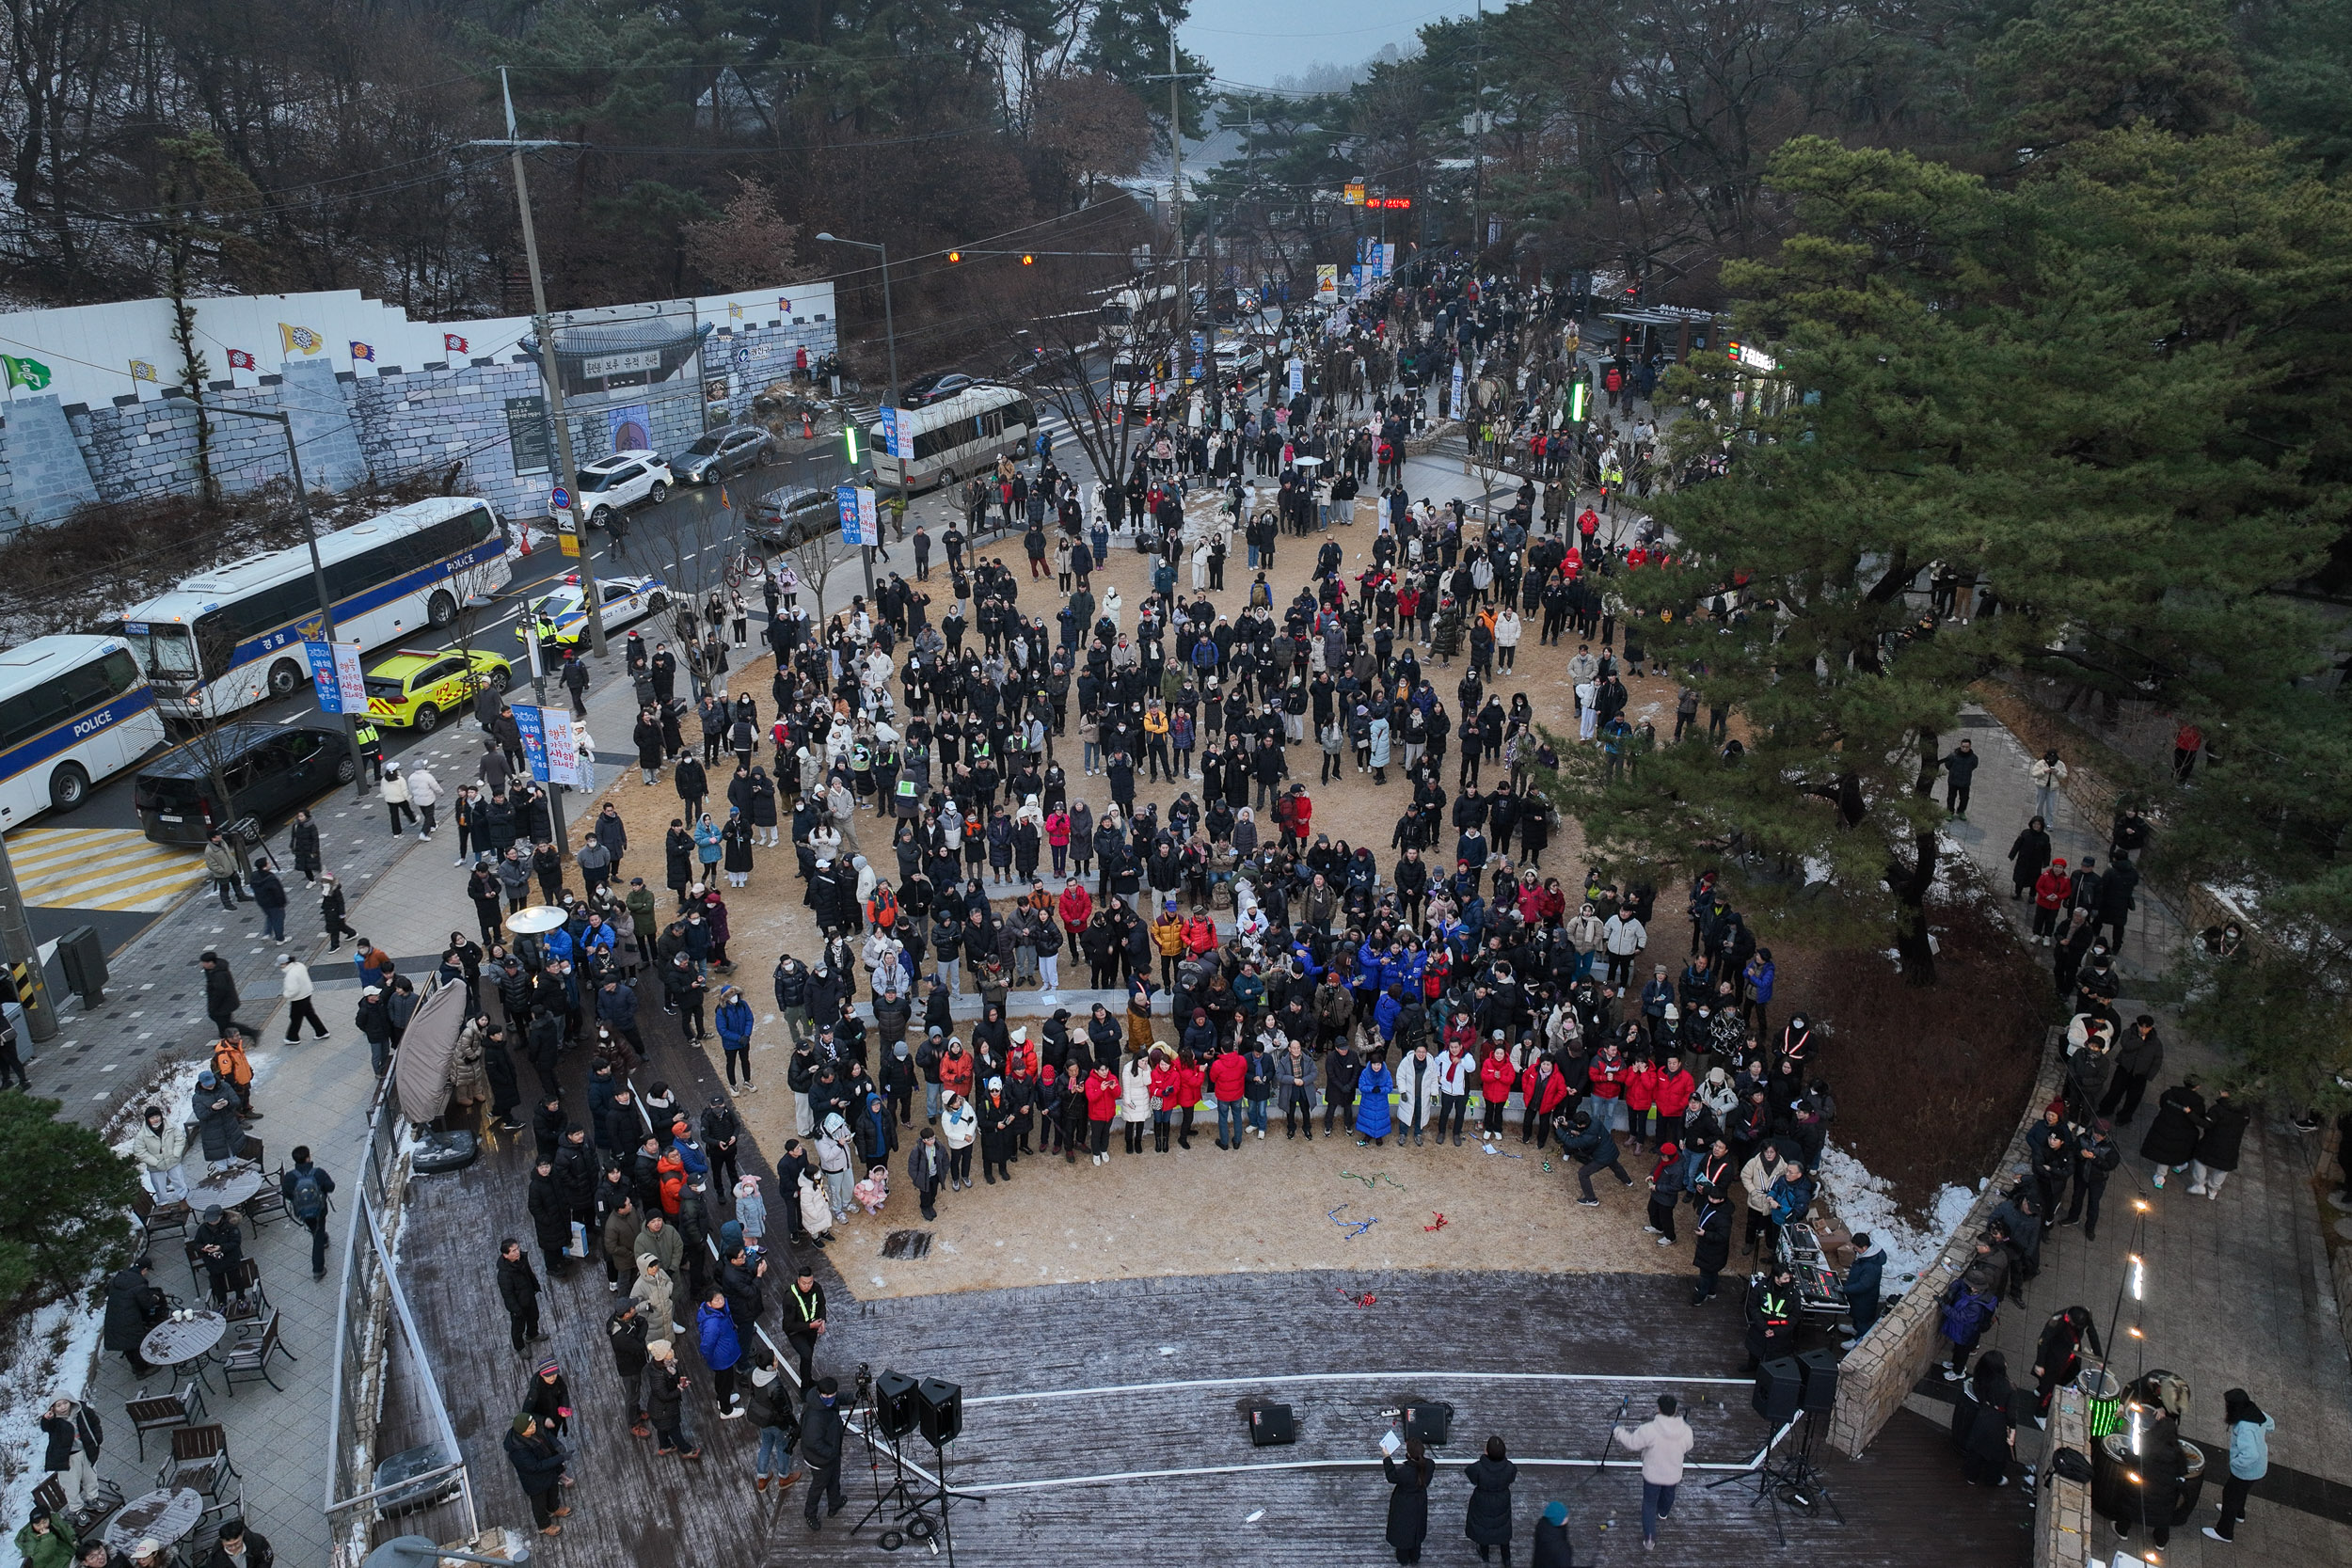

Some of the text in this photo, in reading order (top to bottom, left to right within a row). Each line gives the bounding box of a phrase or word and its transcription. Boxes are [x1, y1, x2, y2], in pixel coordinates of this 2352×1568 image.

[605, 358, 620, 371] 보루
[624, 356, 640, 369] 유적
[446, 553, 475, 572] POLICE
[600, 611, 612, 621] OLICE
[308, 648, 330, 657] 2024
[312, 659, 332, 669] 새해
[339, 657, 357, 673] 행복
[341, 681, 363, 691] 새해
[436, 682, 450, 696] 119
[515, 712, 538, 721] 2024
[73, 710, 112, 737] POLICE
[548, 723, 566, 740] 행복
[549, 740, 571, 751] 가득한
[549, 749, 575, 761] 새해
[552, 759, 575, 769] 되세요
